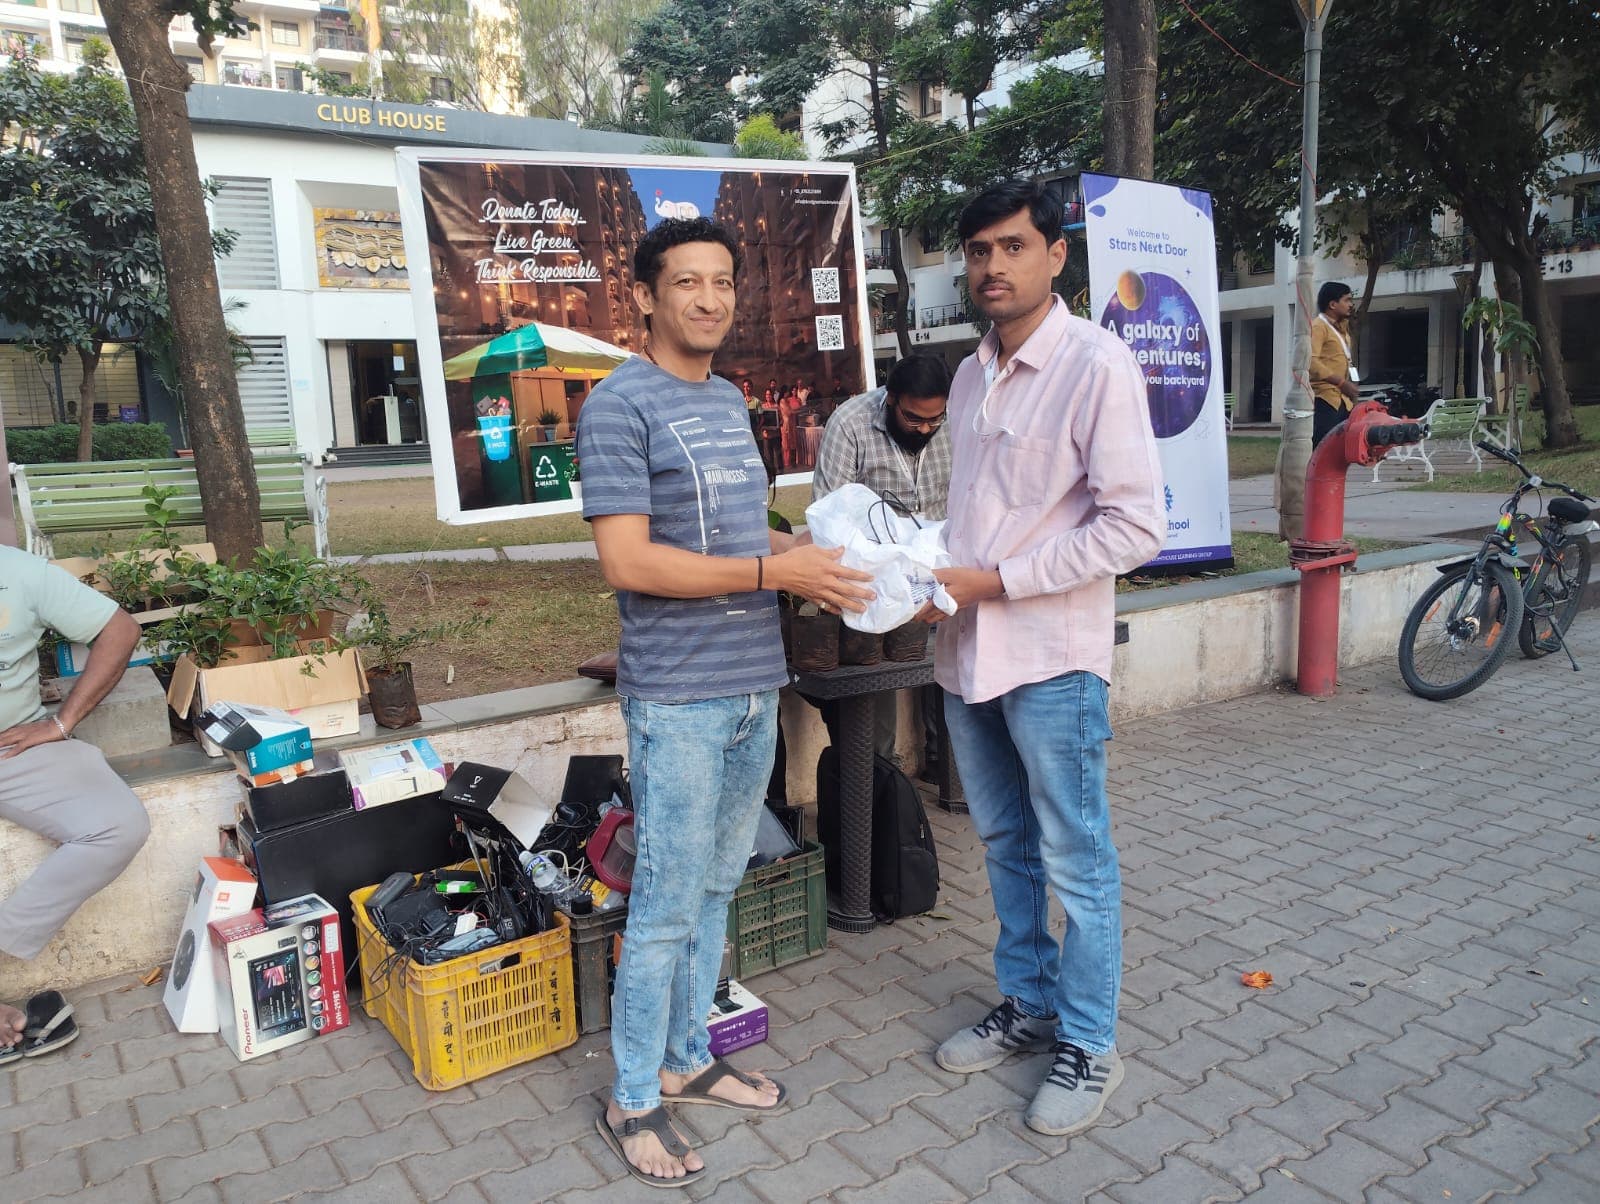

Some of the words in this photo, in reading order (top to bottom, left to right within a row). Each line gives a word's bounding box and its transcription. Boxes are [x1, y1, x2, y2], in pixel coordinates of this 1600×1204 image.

[316, 103, 371, 125] CLUB
[378, 109, 447, 132] HOUSE
[481, 197, 537, 221] Donate
[539, 198, 583, 226] Today.
[493, 226, 528, 251] Live
[531, 229, 576, 255] Green.
[1109, 238, 1137, 252] Stars
[1139, 241, 1163, 254] Next
[1165, 243, 1188, 257] Door
[1127, 228, 1160, 240] Welcome
[1161, 231, 1170, 240] to
[474, 258, 516, 281] Think
[519, 257, 601, 284] Responsible.
[1107, 319, 1119, 336] A
[1122, 319, 1182, 346] galaxy
[1186, 322, 1200, 342] of
[1163, 374, 1205, 389] backyard
[244, 1008, 253, 1055] Pioneer
